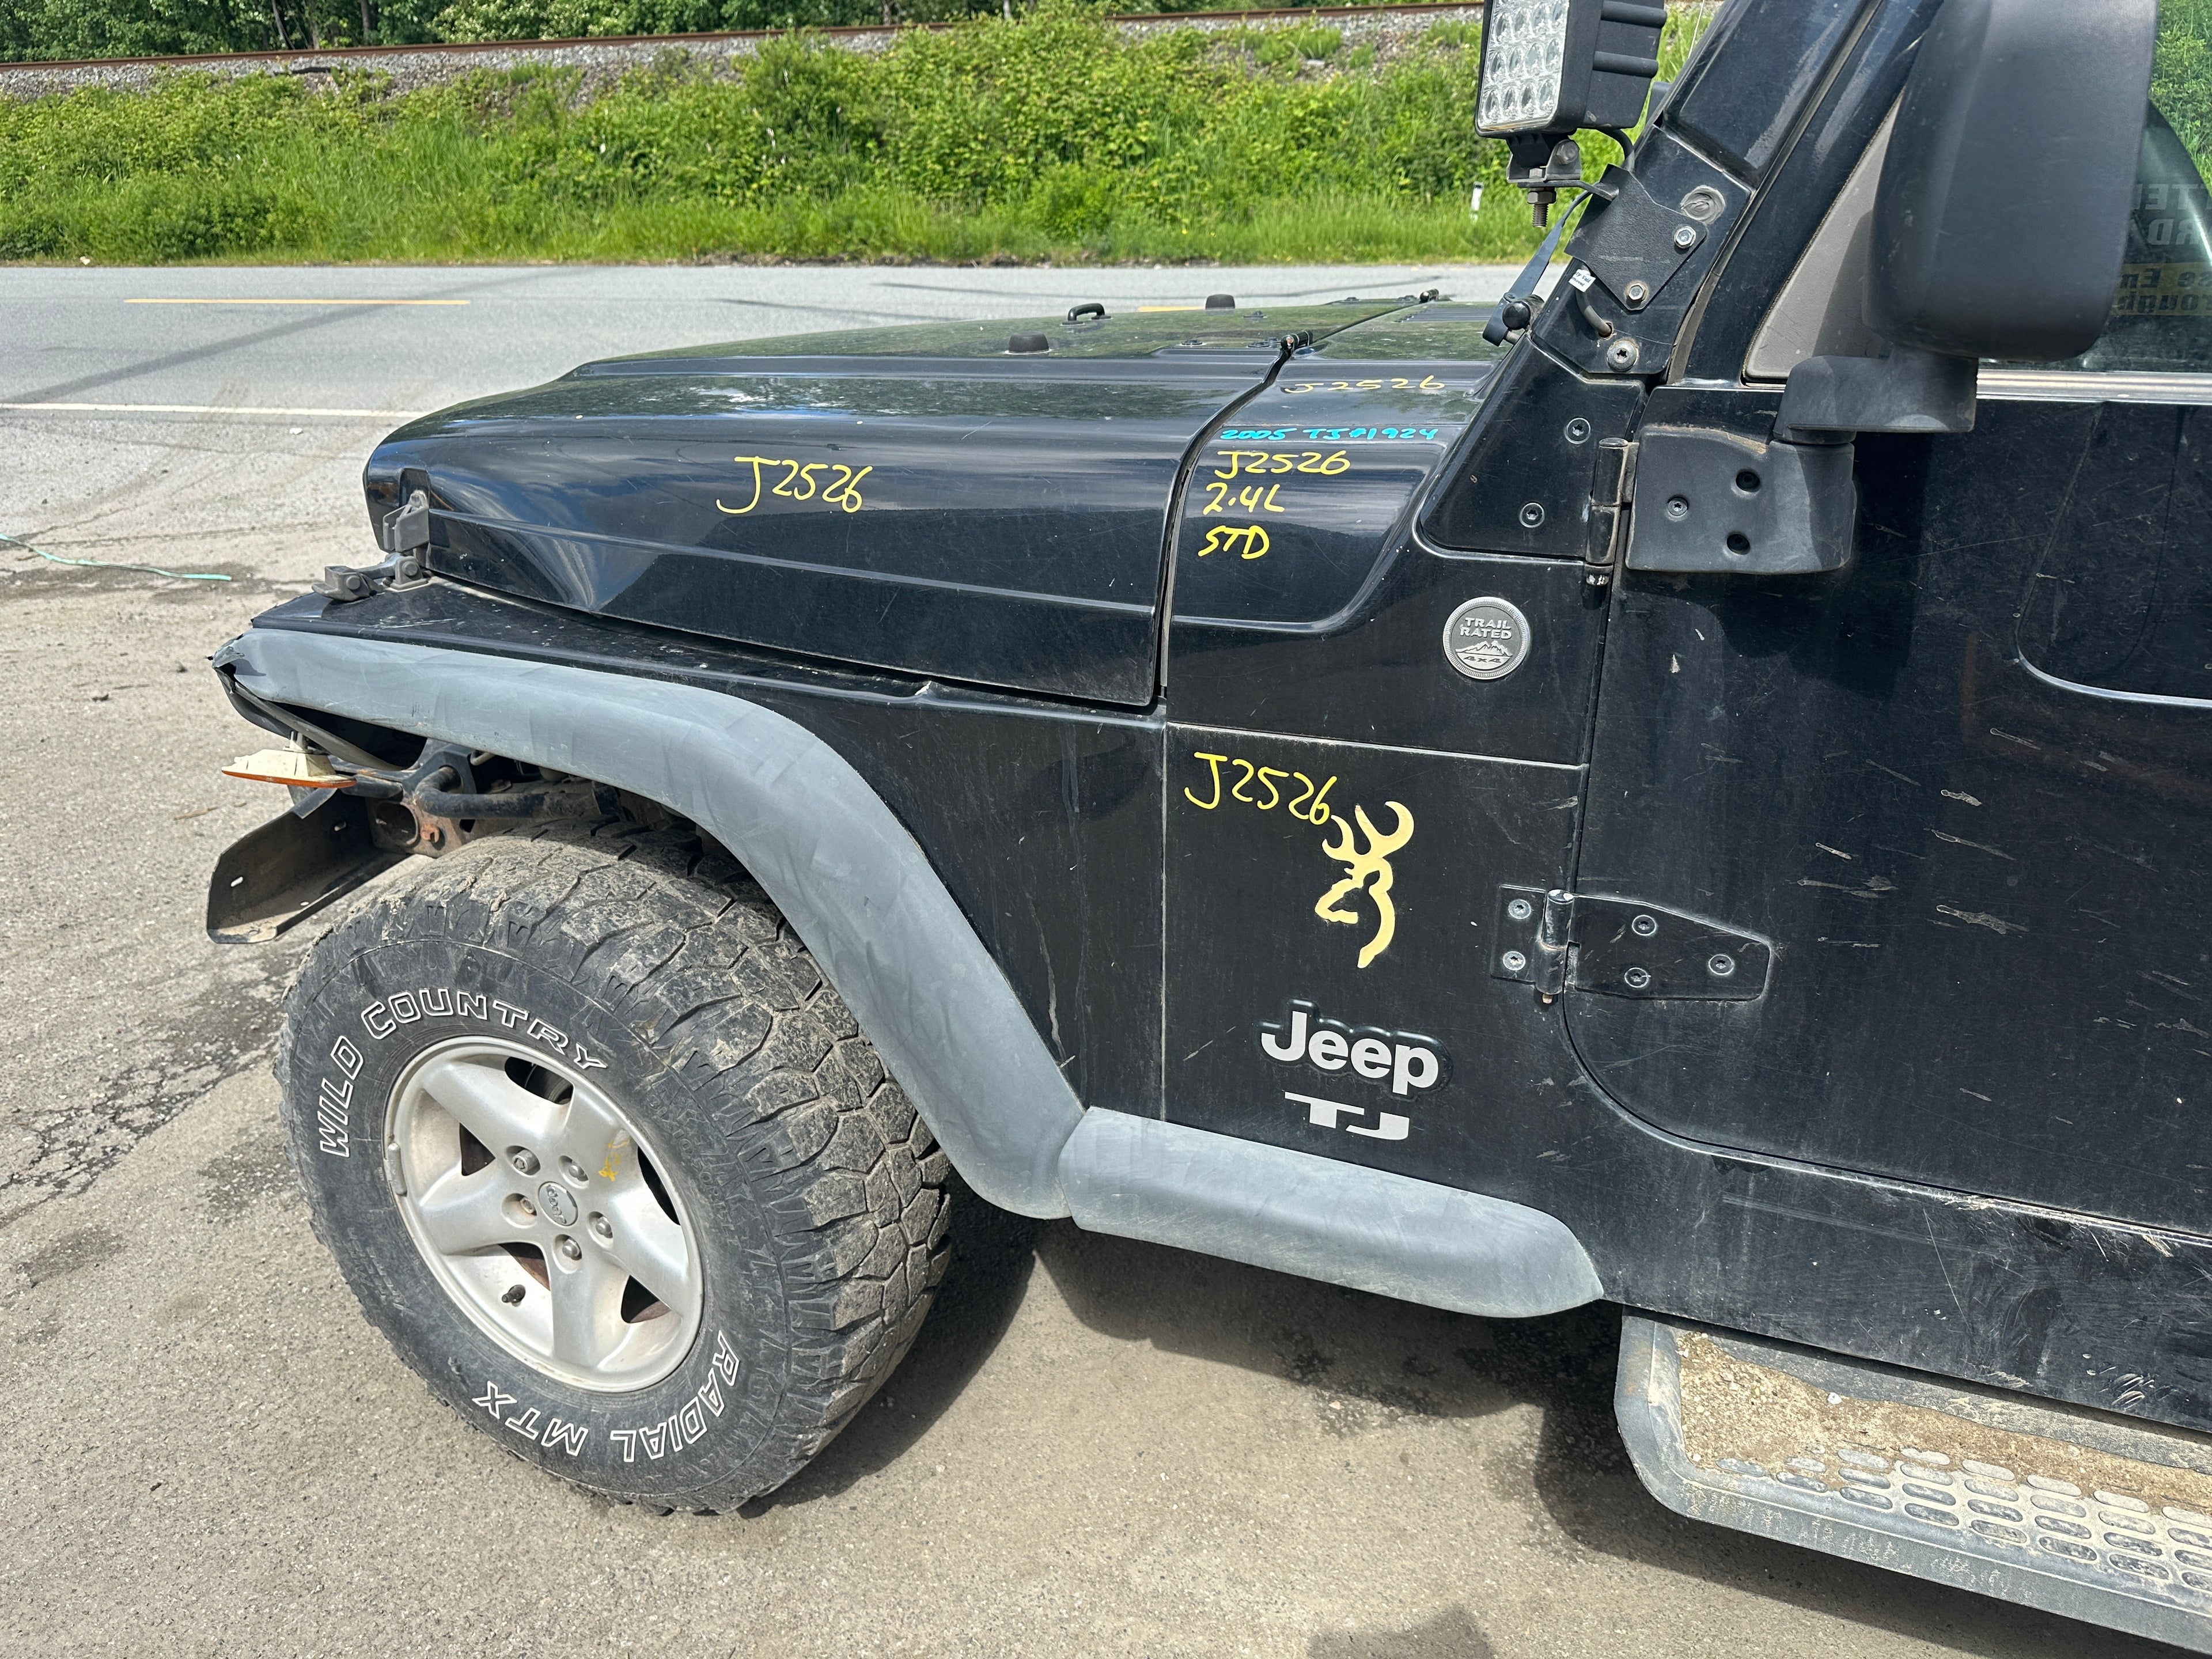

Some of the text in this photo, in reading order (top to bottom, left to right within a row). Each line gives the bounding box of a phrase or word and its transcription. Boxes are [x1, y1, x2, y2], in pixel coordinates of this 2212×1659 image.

[1285, 376, 1445, 393] J2526
[1220, 428, 1297, 440] 2005
[1214, 450, 1351, 479] J2526
[716, 456, 873, 514] J2526
[1202, 482, 1285, 515] 2.4L
[1198, 525, 1270, 559] STD
[1459, 626, 1513, 639] RATED
[1465, 617, 1512, 630] TRAIL
[1184, 751, 1338, 825] J2526
[1261, 1011, 1439, 1095] Jeep
[317, 987, 608, 1158] WILD COUNTRY
[1285, 1092, 1410, 1141] TJ
[472, 1329, 740, 1463] RADIAL MTX
